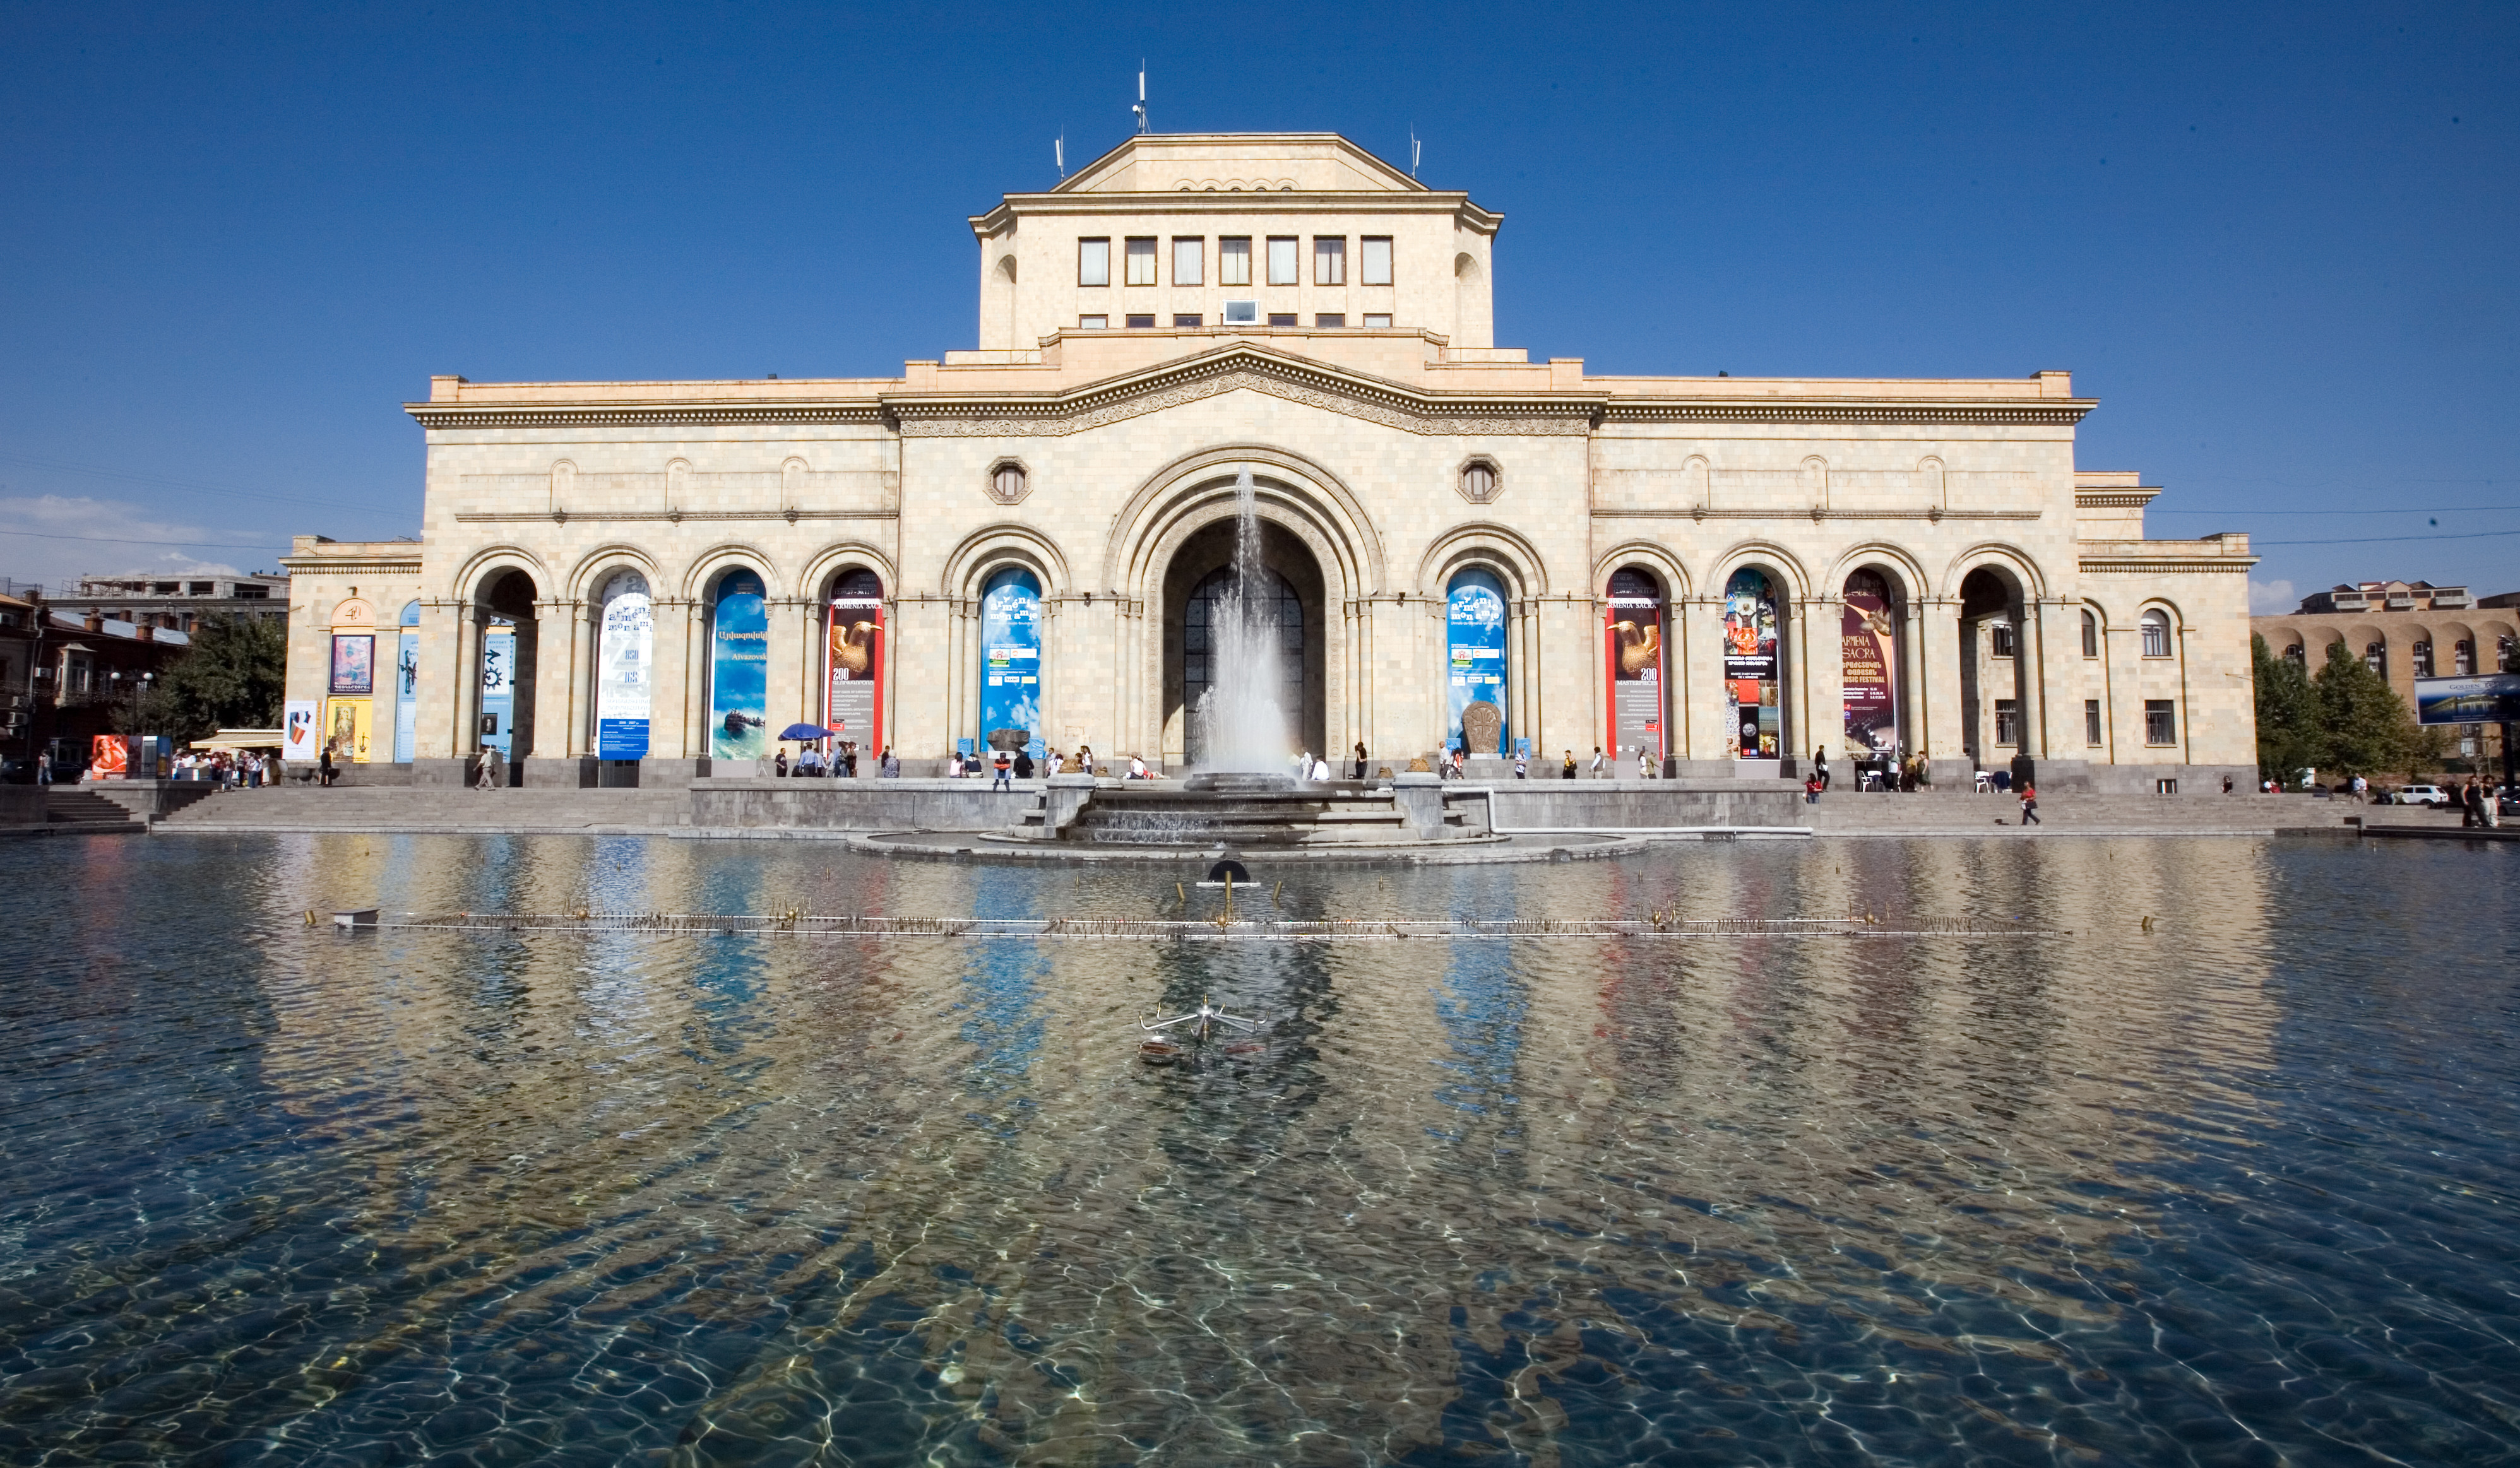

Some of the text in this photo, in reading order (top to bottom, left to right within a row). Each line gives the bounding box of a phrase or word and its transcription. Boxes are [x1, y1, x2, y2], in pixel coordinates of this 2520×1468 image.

[990, 597, 1037, 611] arménie
[1451, 597, 1499, 611] arménie
[1014, 610, 1038, 621] amie
[1451, 610, 1500, 621] mon amie
[608, 623, 631, 631] mon
[1842, 636, 1870, 646] ARMENIA
[625, 649, 639, 660] 850
[1842, 648, 1875, 659] SACRA
[624, 671, 638, 683] 165
[833, 667, 849, 680] 200
[1641, 667, 1657, 680] 200
